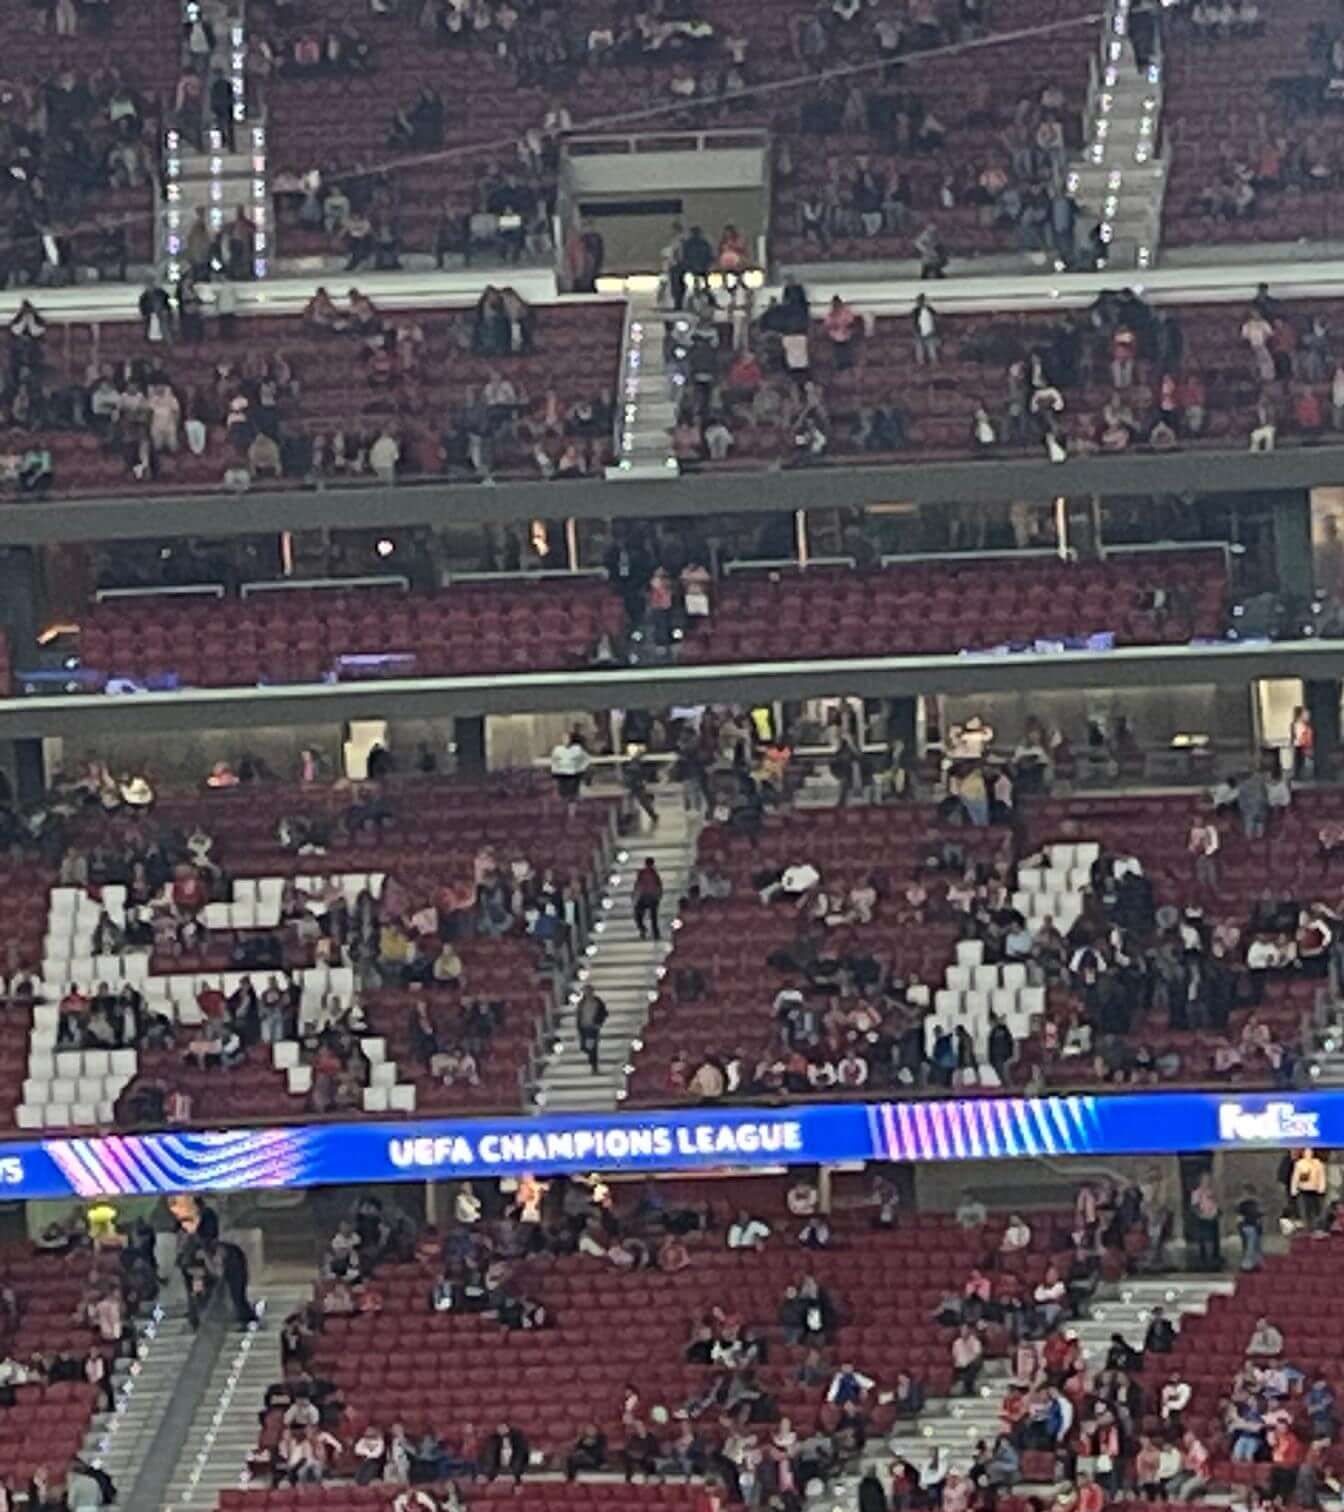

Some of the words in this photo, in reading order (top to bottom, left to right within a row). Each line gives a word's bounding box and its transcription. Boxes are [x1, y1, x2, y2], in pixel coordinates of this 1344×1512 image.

[1219, 1102, 1321, 1141] FedEx
[389, 1137, 474, 1167] UEFA
[479, 1127, 671, 1163] CHAMPIONS
[677, 1122, 802, 1154] LEAGUE
